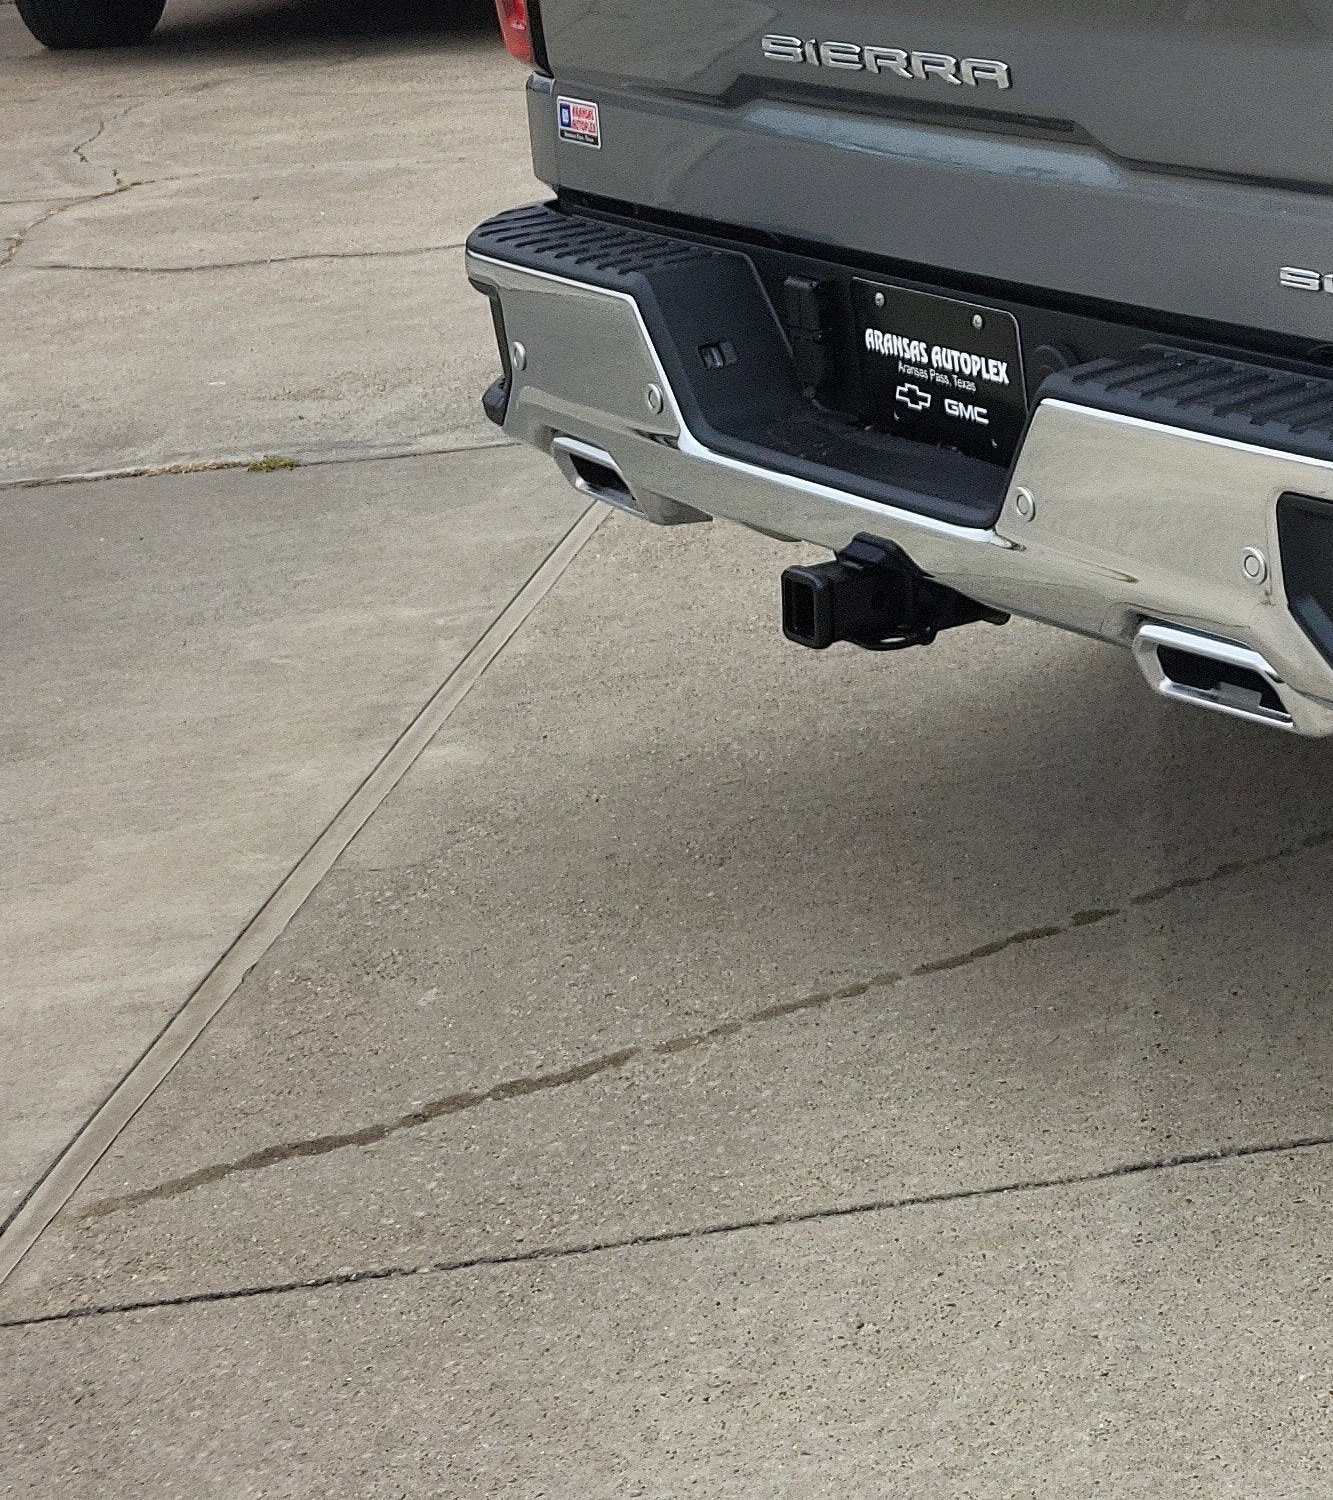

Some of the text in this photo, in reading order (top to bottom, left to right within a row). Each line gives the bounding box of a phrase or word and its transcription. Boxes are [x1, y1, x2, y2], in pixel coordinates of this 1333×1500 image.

[761, 34, 1012, 89] SIERRA
[865, 328, 1010, 385] ARANSAS AUTOPLEX
[898, 360, 929, 380] Aransas
[953, 374, 977, 392] Texas
[944, 398, 990, 424] GMC
